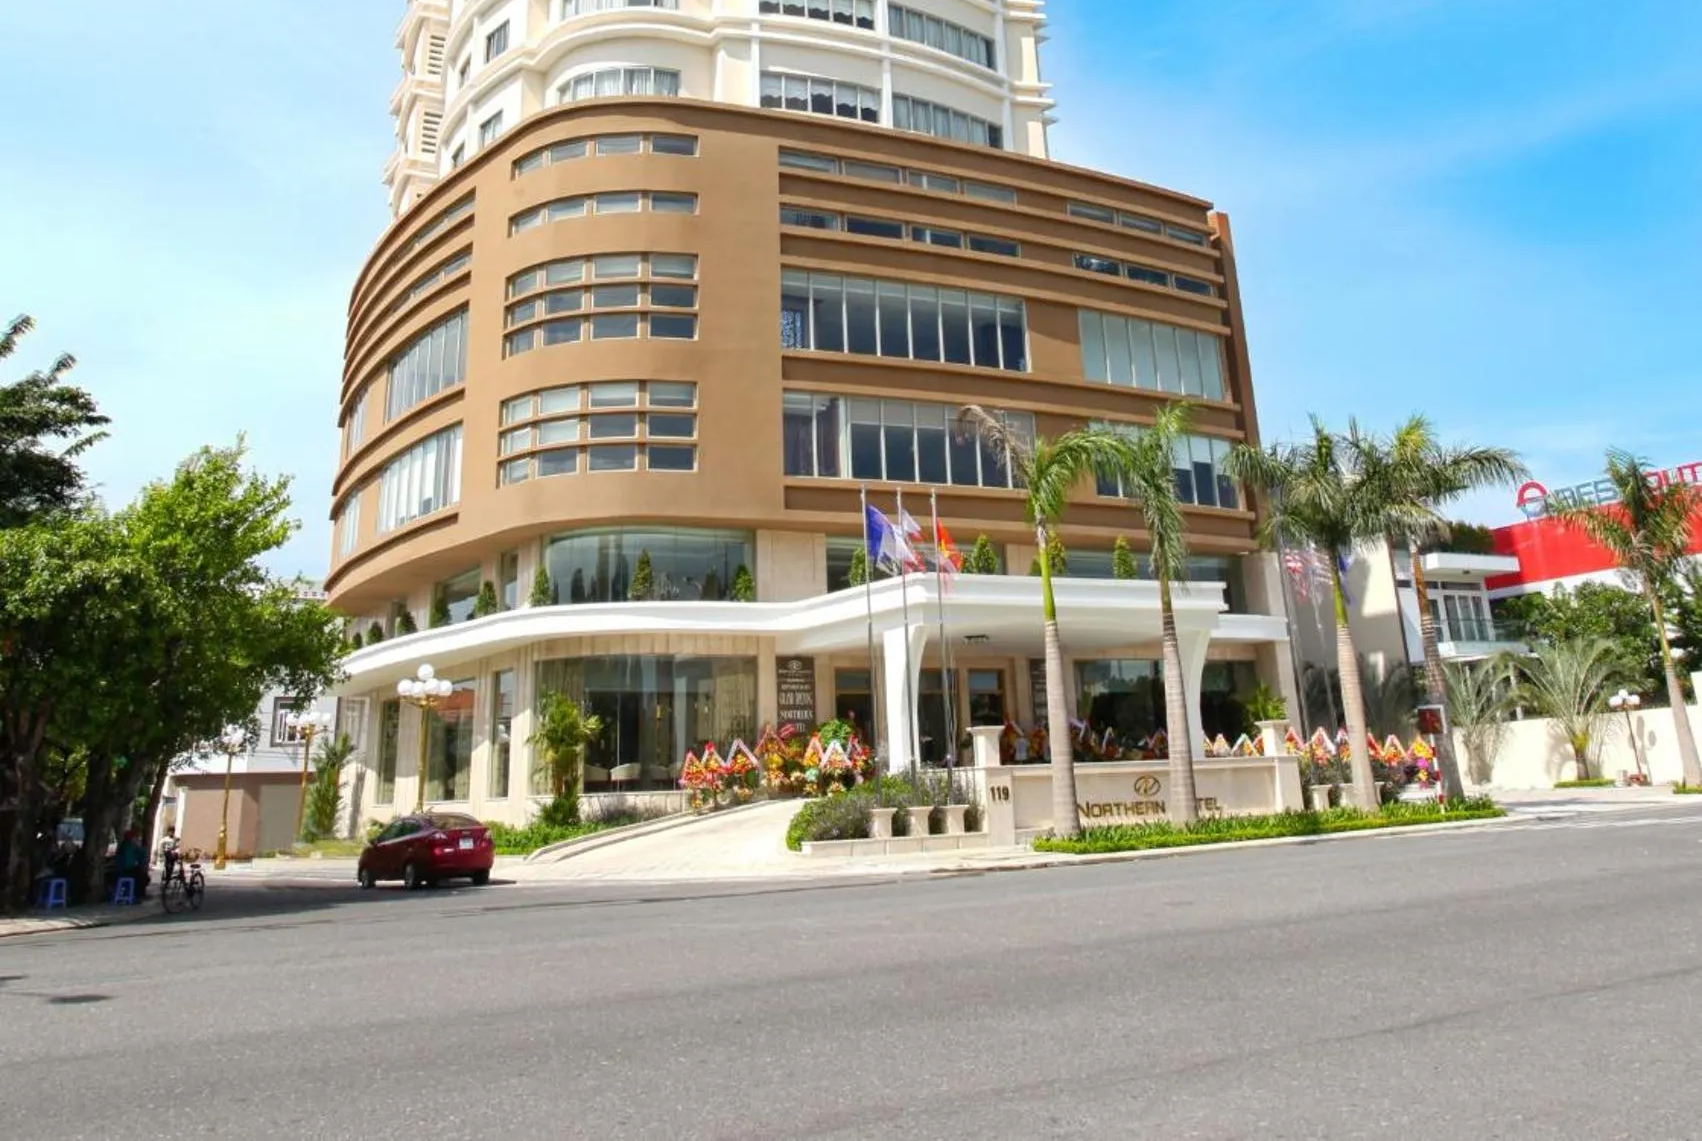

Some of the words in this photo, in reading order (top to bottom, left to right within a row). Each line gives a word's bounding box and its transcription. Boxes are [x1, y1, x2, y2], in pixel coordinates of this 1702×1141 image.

[990, 785, 1009, 802] 119
[1077, 800, 1166, 819] NORTHERN
[1195, 796, 1222, 811] TEL
